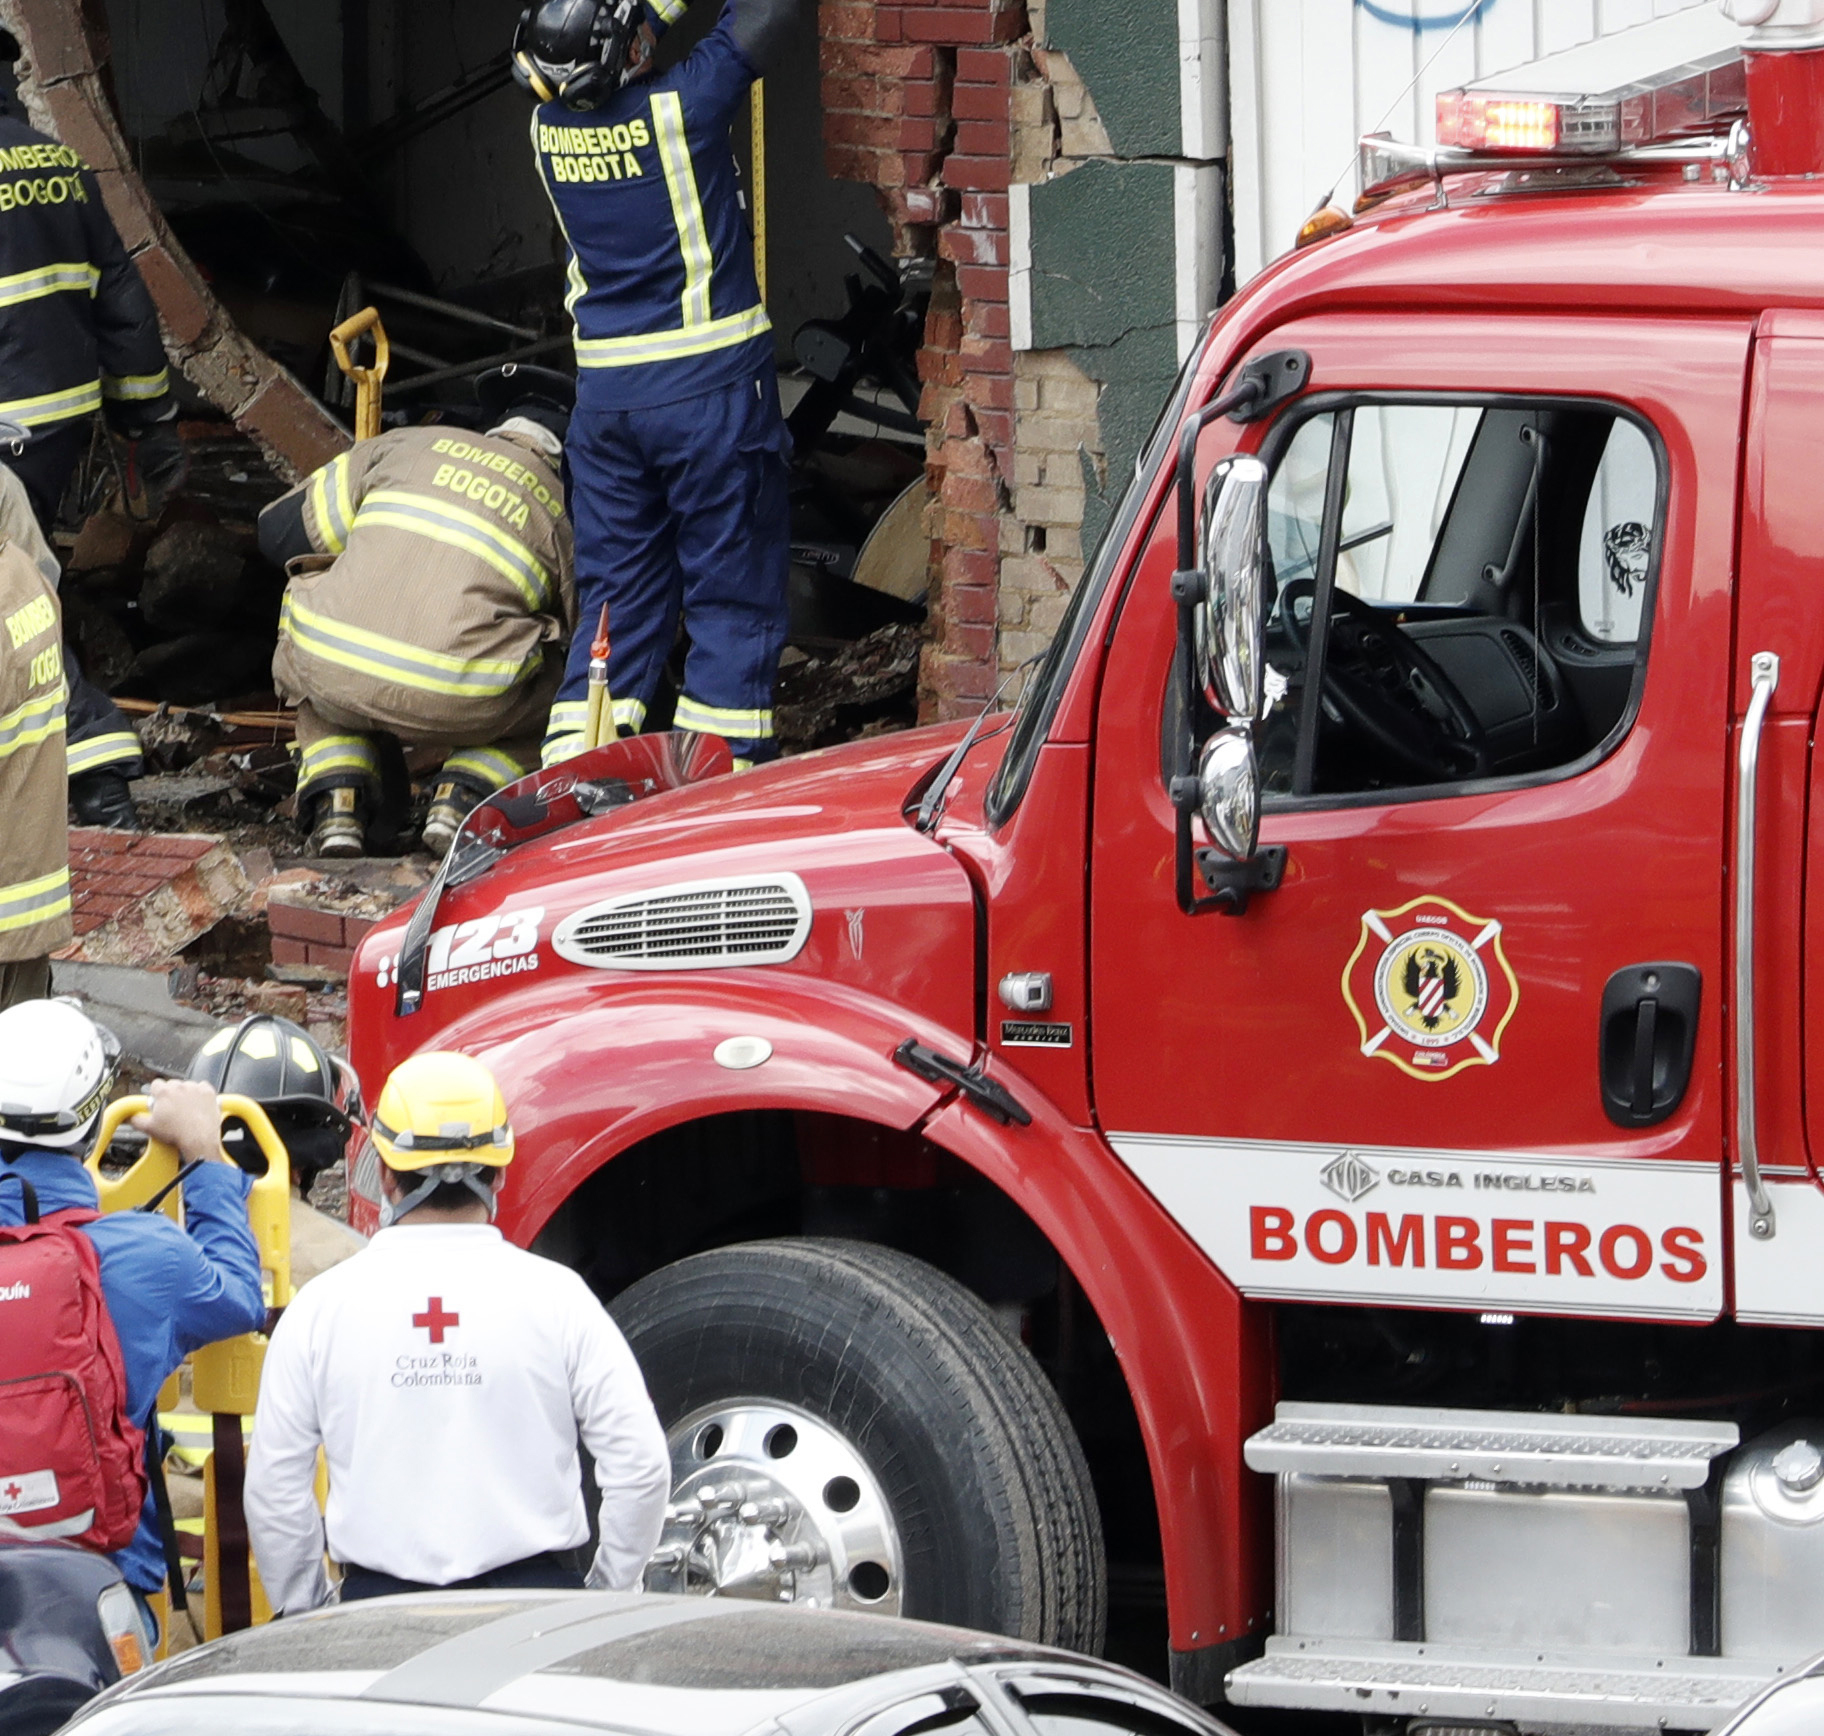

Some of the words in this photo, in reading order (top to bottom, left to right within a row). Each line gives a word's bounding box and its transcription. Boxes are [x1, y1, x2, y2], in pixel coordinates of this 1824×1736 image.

[539, 119, 650, 154] BOMBEROS
[551, 151, 643, 183] BOGOTA
[432, 437, 565, 518] BOMBEROS
[433, 464, 530, 531] BOGOTA
[426, 905, 545, 974] 123
[427, 953, 539, 991] EMERGENCIAS
[1387, 1168, 1464, 1189] CASA
[1473, 1173, 1597, 1194] INGLESA
[1249, 1205, 1708, 1283] BOMBEROS
[391, 1371, 482, 1388] Colombiana
[396, 1354, 438, 1369] Cruz
